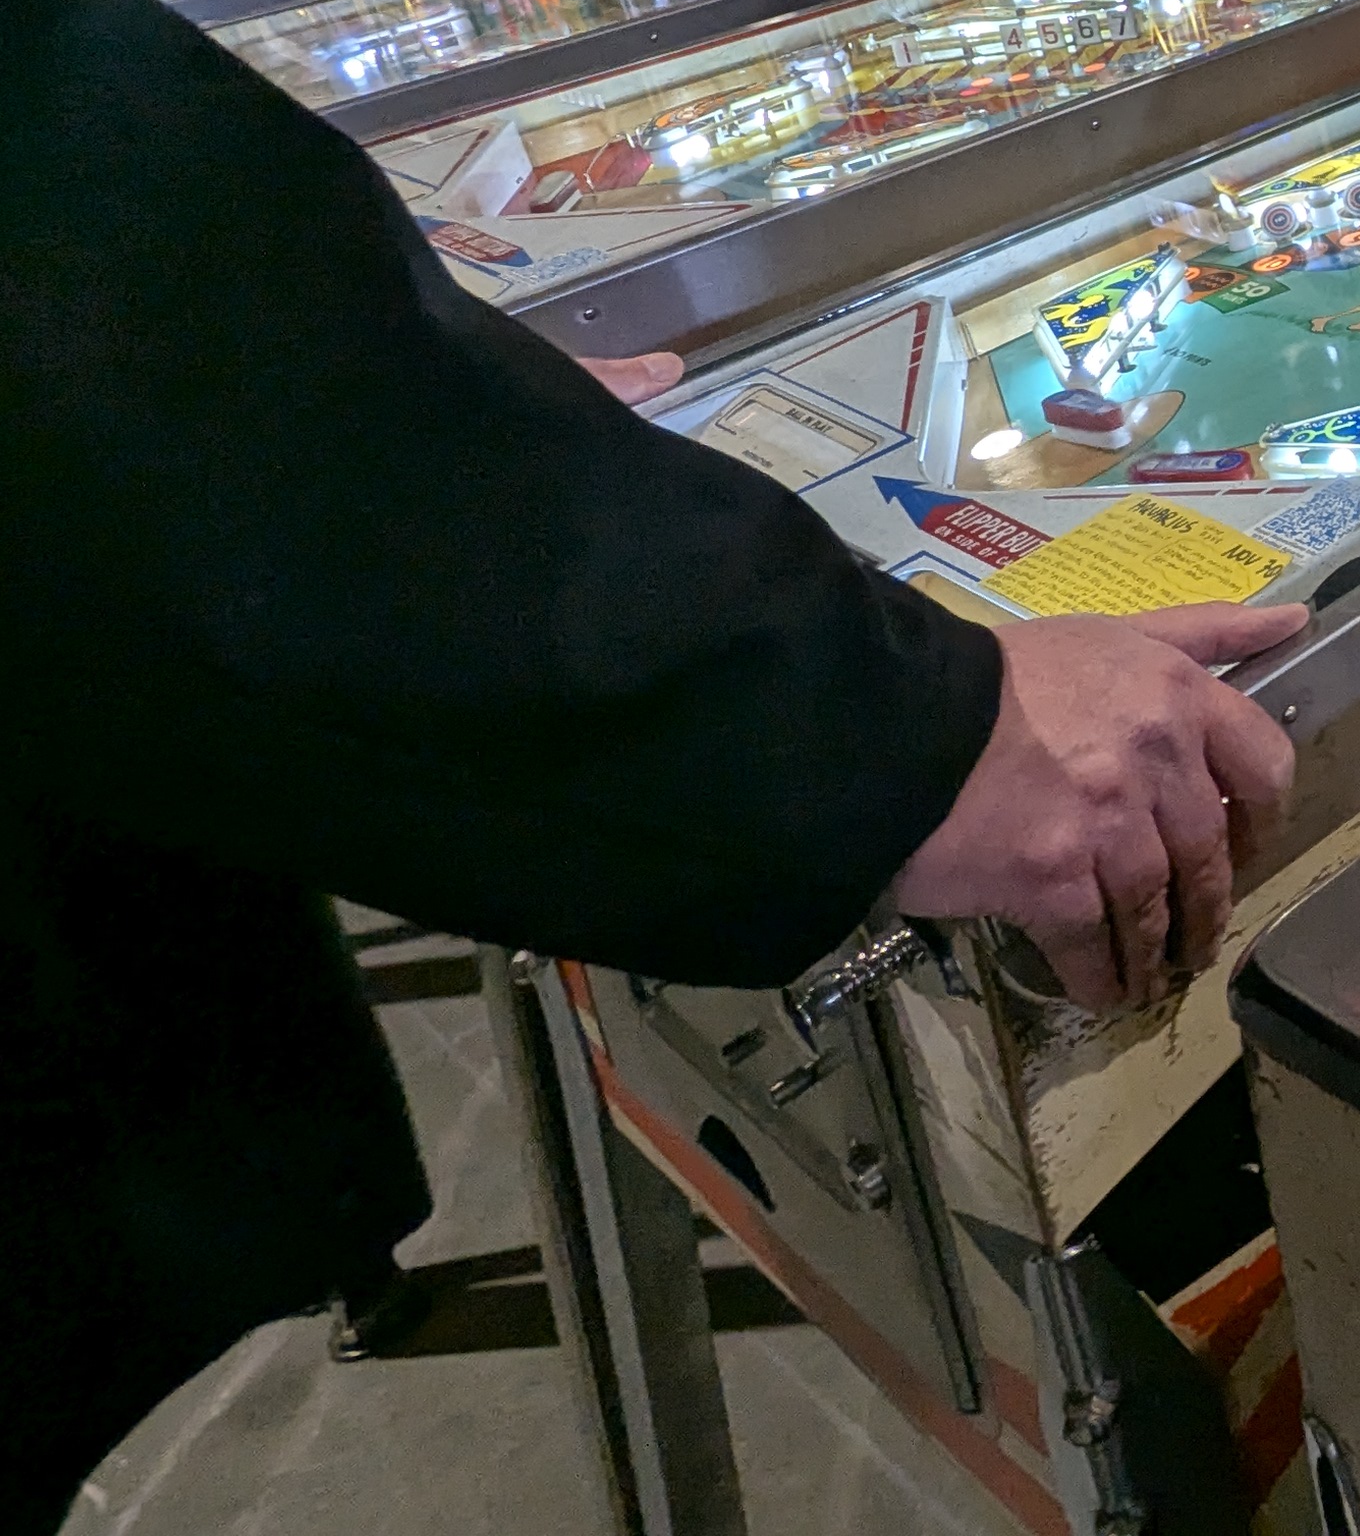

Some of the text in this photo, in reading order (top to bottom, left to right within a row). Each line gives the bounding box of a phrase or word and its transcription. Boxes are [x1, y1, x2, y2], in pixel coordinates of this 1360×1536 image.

[1006, 15, 1128, 51] 4 5 6 7
[1230, 279, 1272, 300] 50
[944, 503, 1007, 542] FLIPPER
[1128, 498, 1199, 535] AQUARIUS
[934, 525, 994, 558] ON SIDE OF
